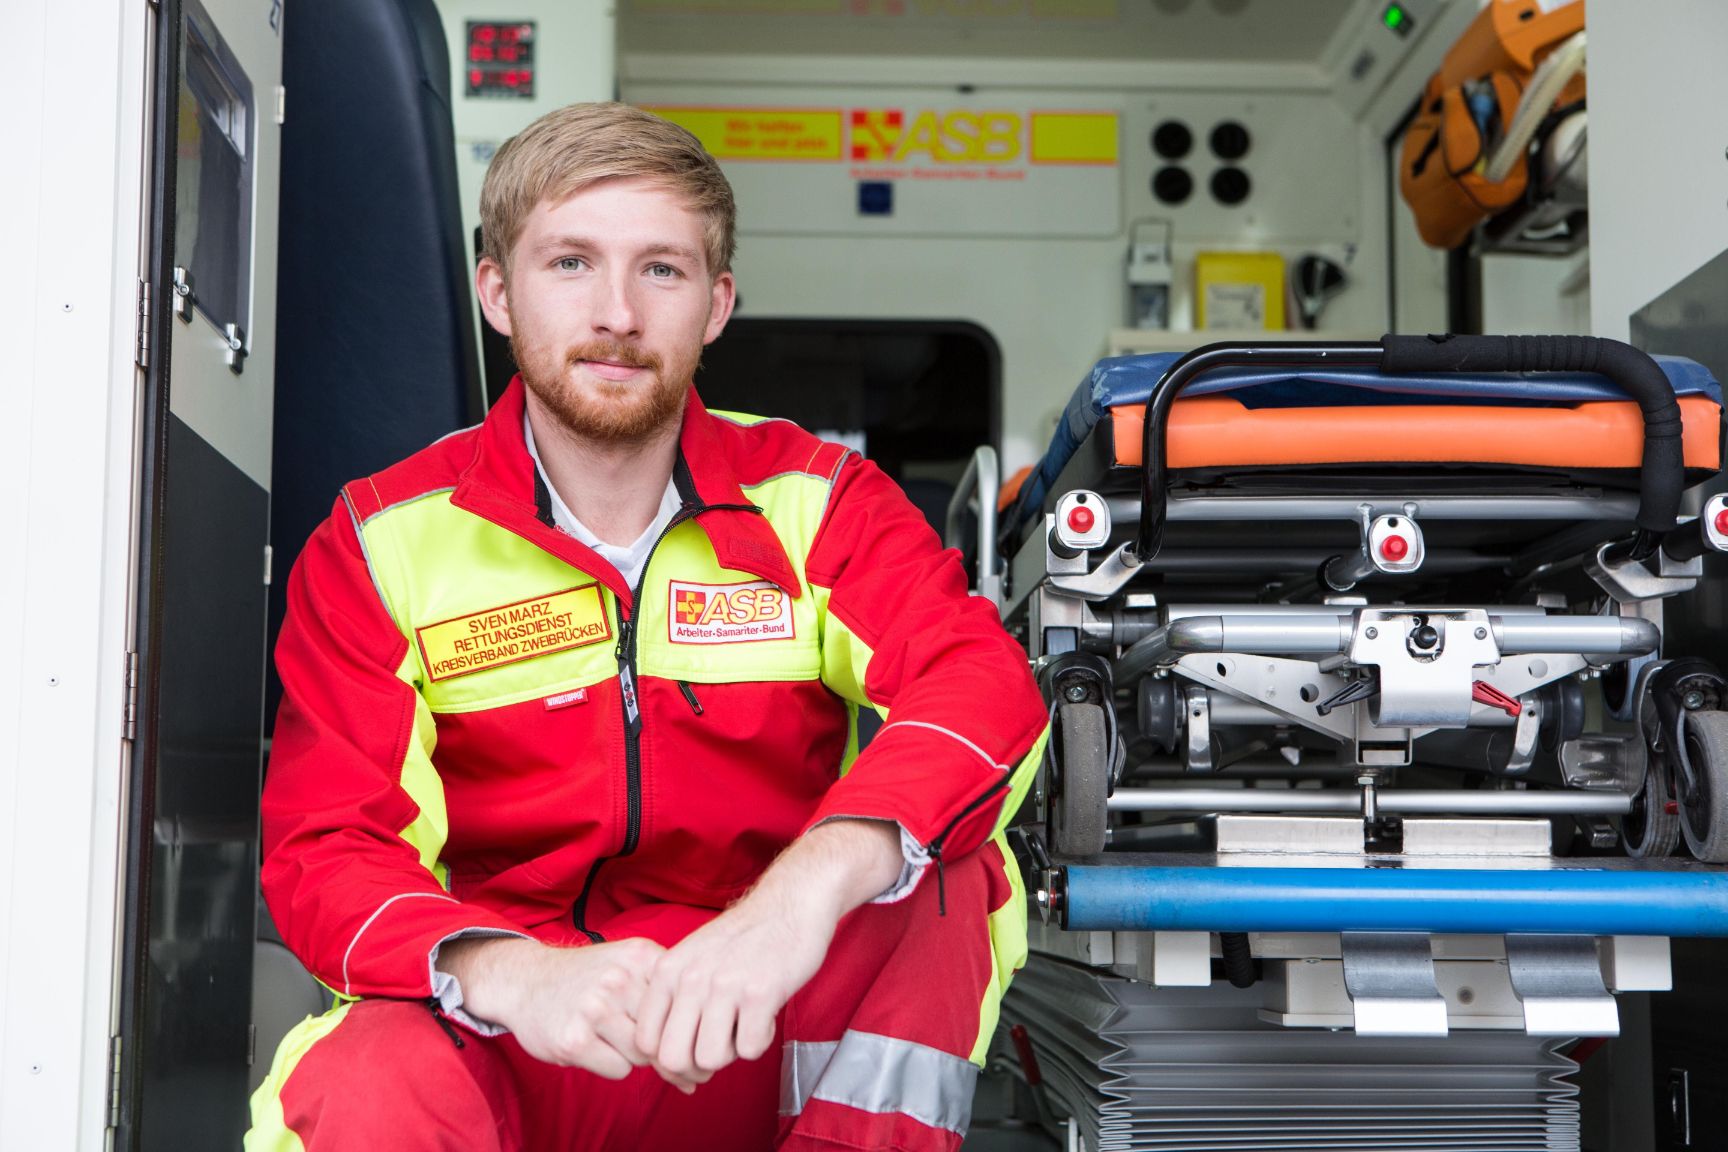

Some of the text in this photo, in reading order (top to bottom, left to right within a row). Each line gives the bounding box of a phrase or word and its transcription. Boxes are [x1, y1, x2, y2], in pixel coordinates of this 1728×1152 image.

[893, 110, 1022, 164] ASB
[468, 602, 553, 634] SVEN MARZ
[699, 588, 783, 625] ASB
[433, 621, 604, 675] KREISVERBAND ZWEIBRÜCKEN
[454, 612, 573, 654] RETTUNGSDIENST
